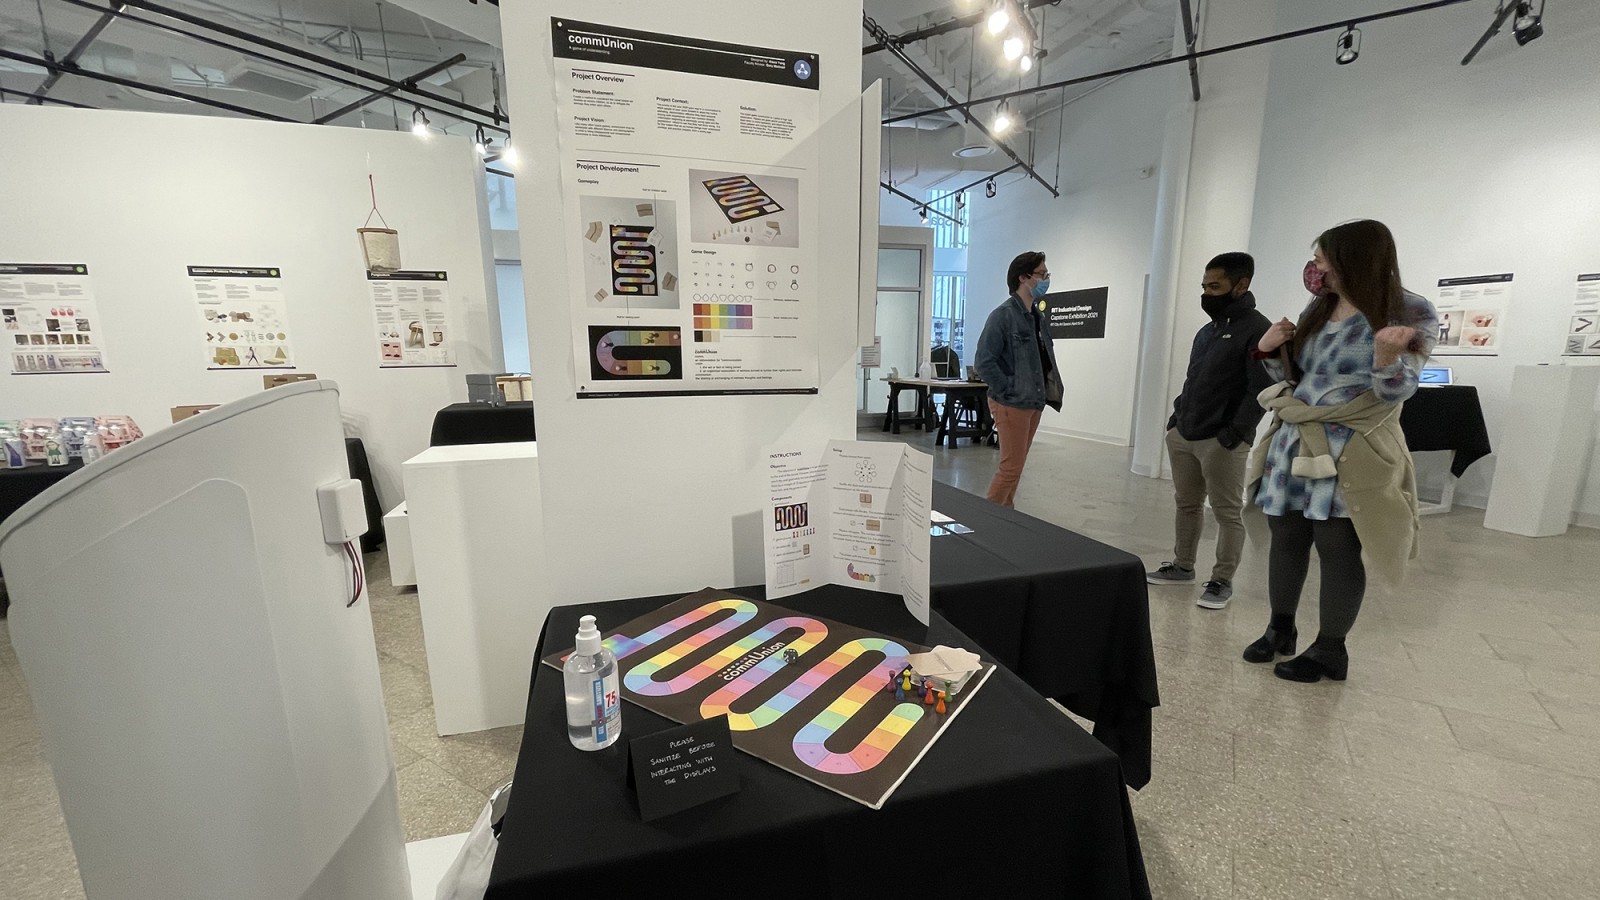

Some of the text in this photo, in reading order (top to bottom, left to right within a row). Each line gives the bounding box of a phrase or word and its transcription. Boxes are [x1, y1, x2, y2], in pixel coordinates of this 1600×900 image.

[568, 35, 634, 51] commUnion
[571, 72, 624, 83] Project Overview
[576, 163, 639, 173] Project Development
[769, 451, 802, 459] INSTRUCTIONS
[723, 641, 786, 681] commUnion
[605, 691, 616, 708] 75
[669, 736, 695, 749] PLEASE
[650, 741, 716, 766] SANITIZE BEFORE
[650, 755, 714, 779] INTERACTING WITH
[683, 765, 717, 780] DISPLAYS
